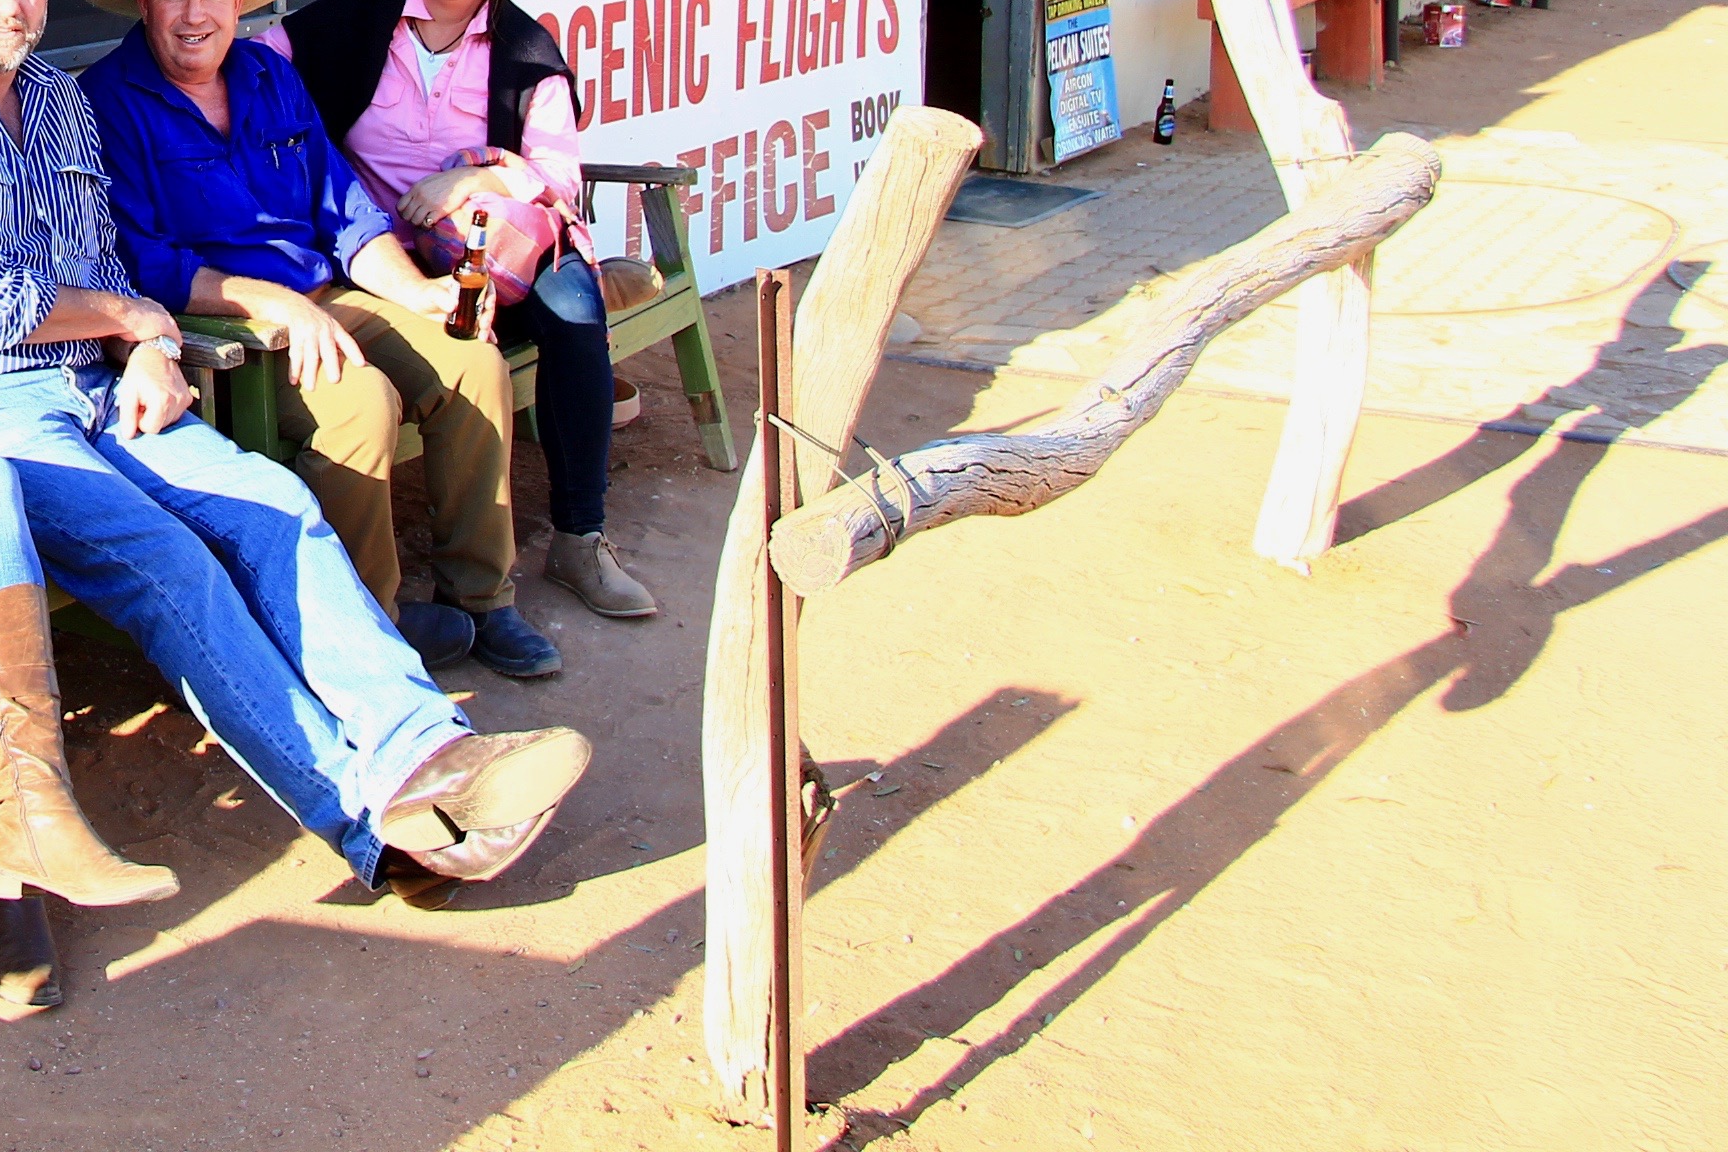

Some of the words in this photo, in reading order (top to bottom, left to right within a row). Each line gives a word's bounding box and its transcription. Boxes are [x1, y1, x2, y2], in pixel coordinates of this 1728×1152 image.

[1067, 17, 1078, 30] THE
[1047, 32, 1079, 72] PELICAN
[1079, 24, 1110, 64] SUITES
[1064, 72, 1093, 94] AIRCON
[1060, 94, 1090, 115] DIGITAL
[1090, 89, 1102, 105] TV
[1067, 110, 1100, 132] ENSUITE
[1056, 132, 1093, 157] DRINKING
[1093, 124, 1117, 145] WATER
